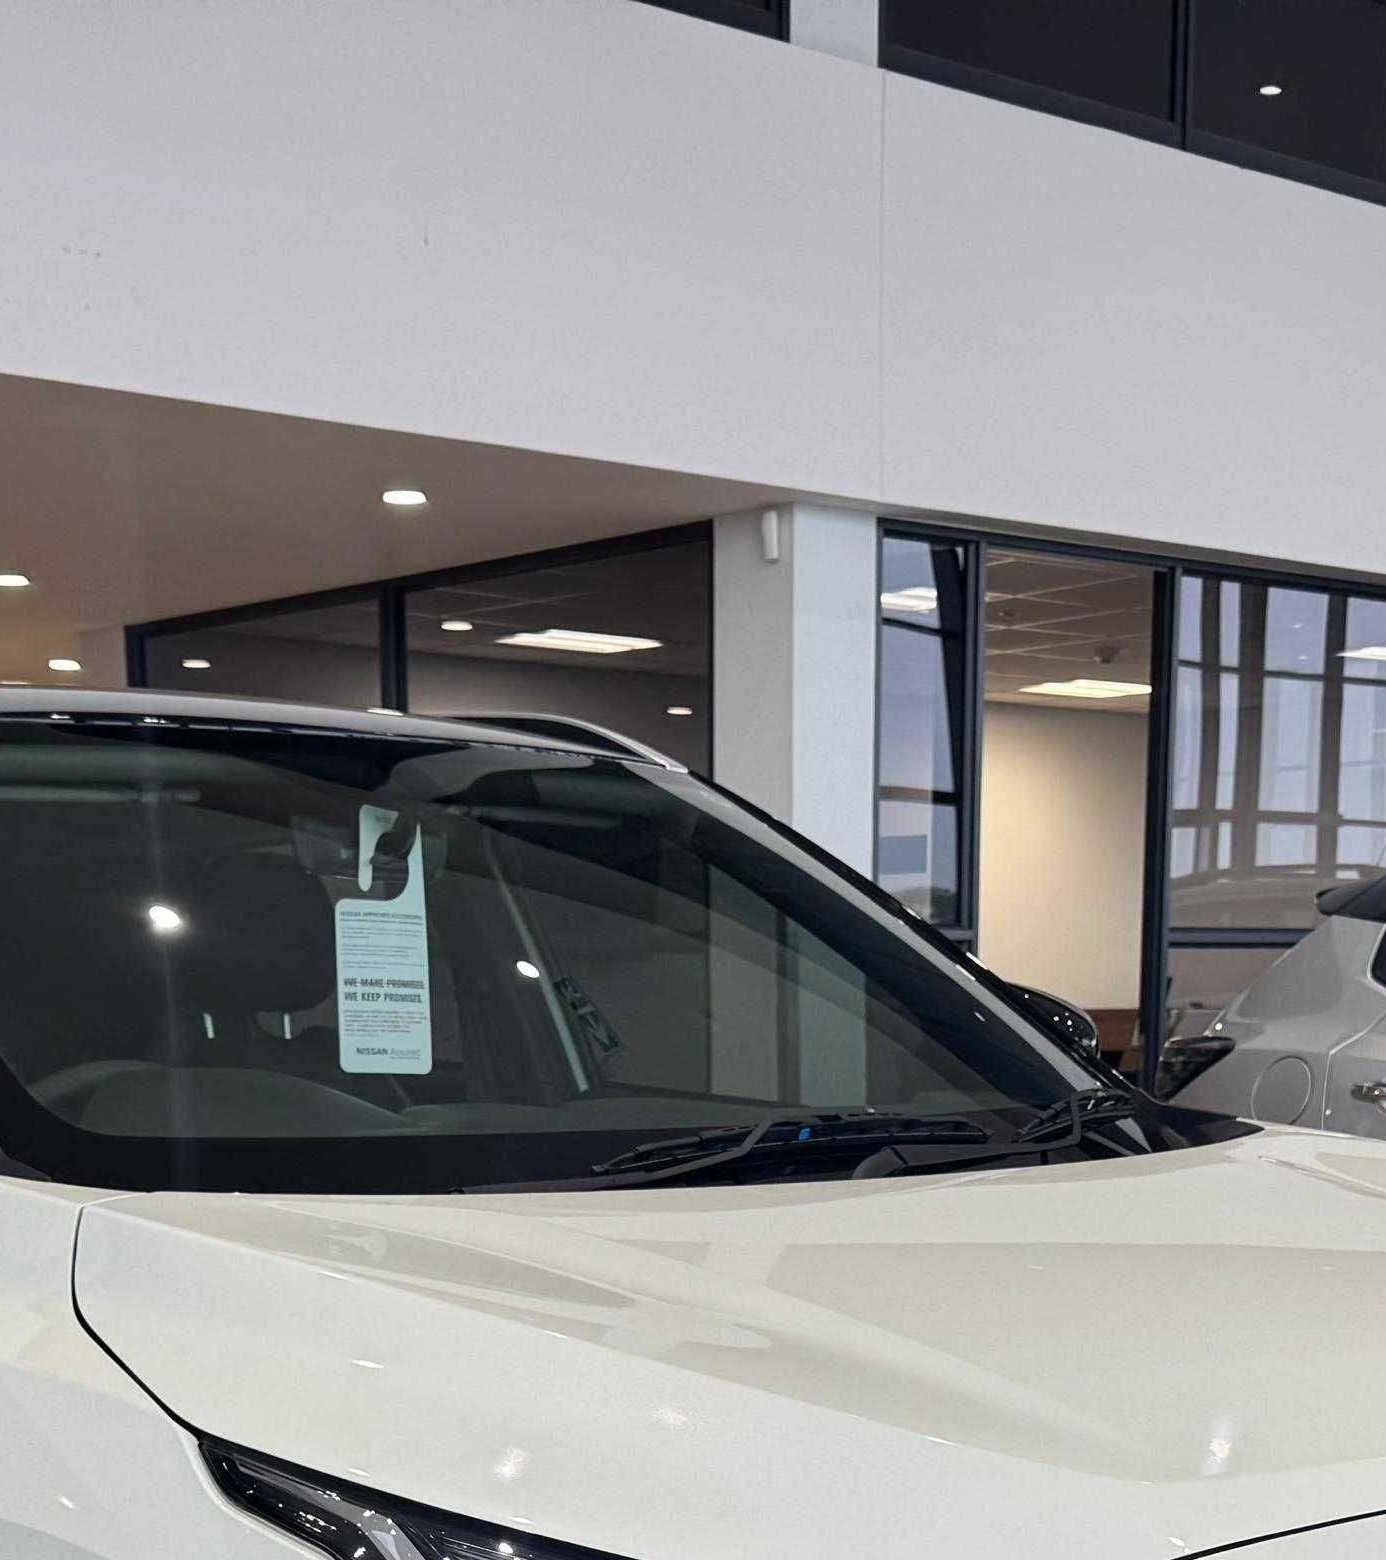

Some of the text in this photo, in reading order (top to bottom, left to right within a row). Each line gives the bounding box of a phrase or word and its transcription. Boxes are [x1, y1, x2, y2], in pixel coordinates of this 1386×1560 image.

[344, 992, 358, 1002] WE
[361, 992, 381, 1002] KEEP
[356, 1047, 388, 1056] NISSAN
